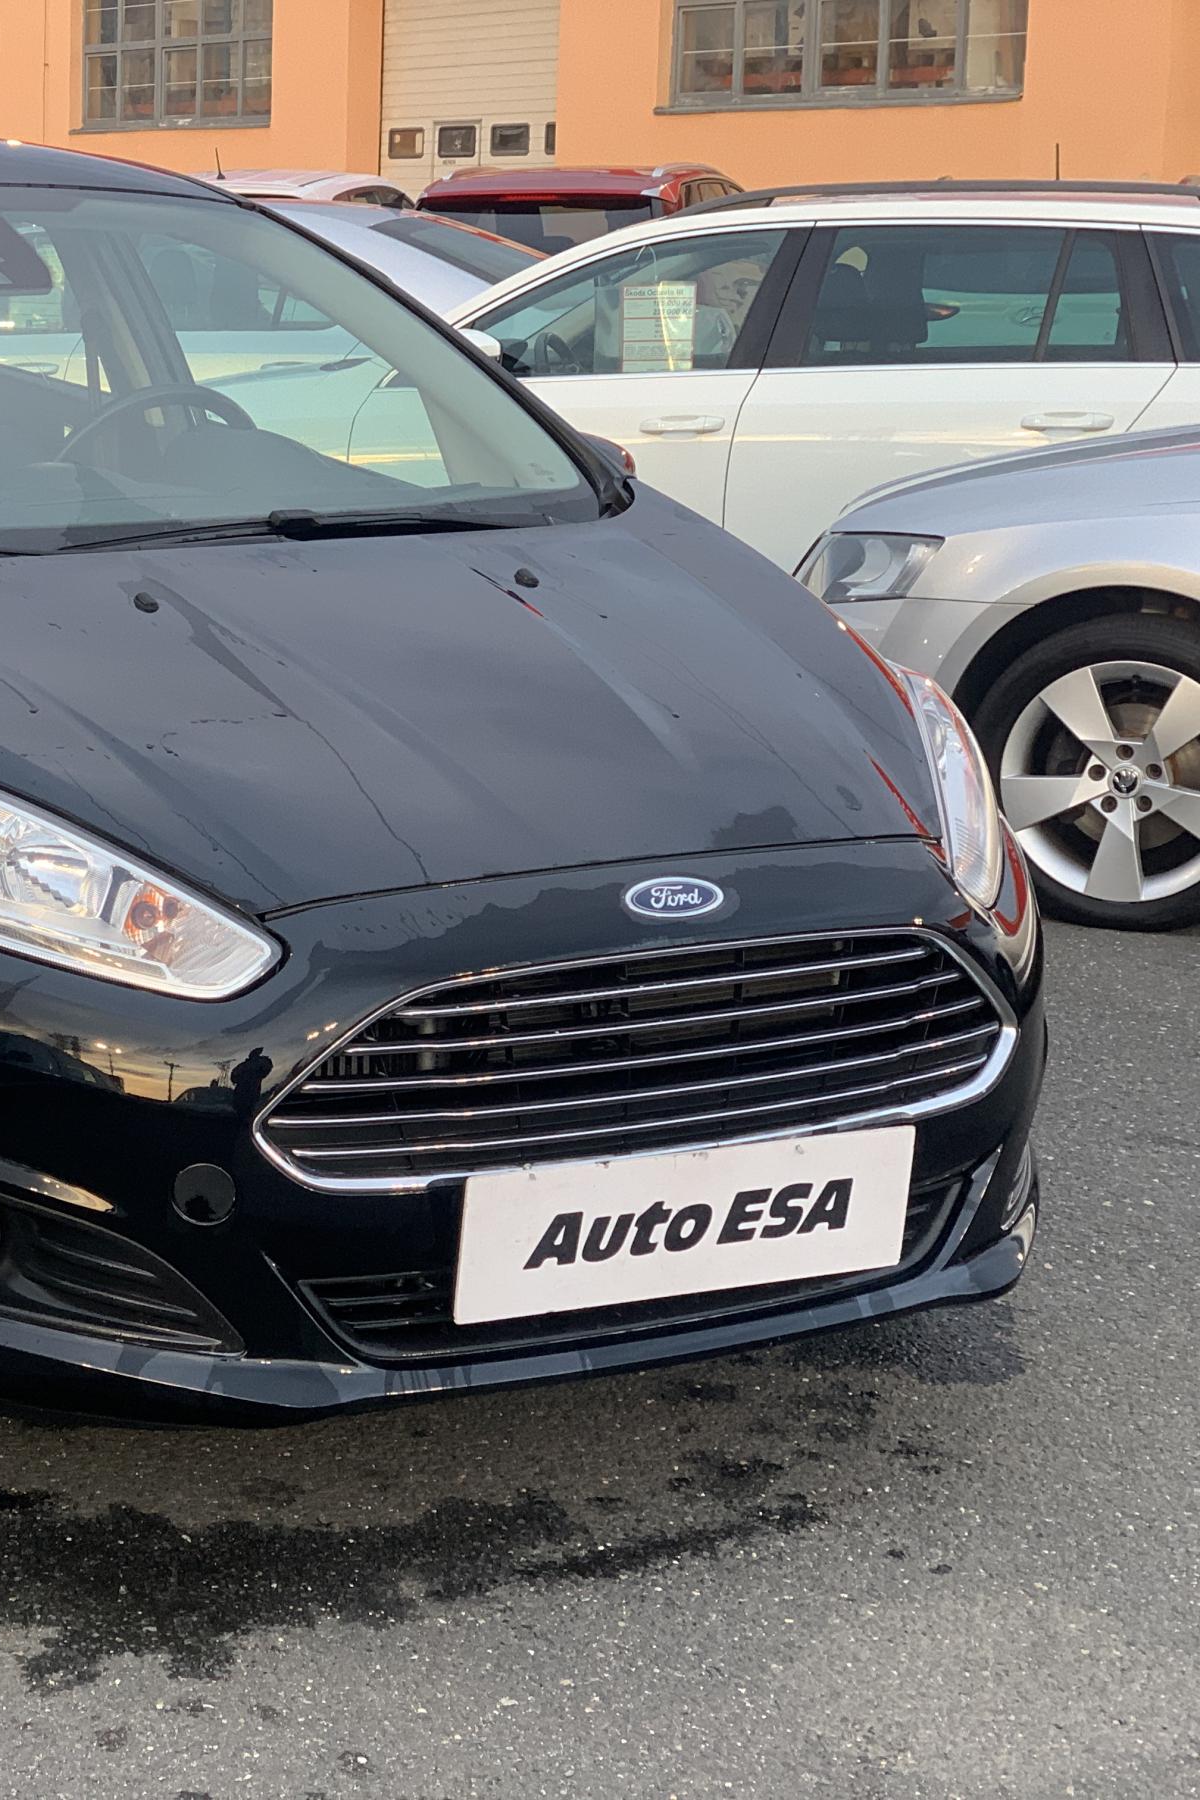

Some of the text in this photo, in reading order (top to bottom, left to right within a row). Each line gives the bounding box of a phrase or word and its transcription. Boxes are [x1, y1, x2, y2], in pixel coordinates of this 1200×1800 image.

[647, 287, 675, 297] Ocavia
[650, 885, 702, 909] Ford
[523, 1178, 854, 1271] Auto ESA
